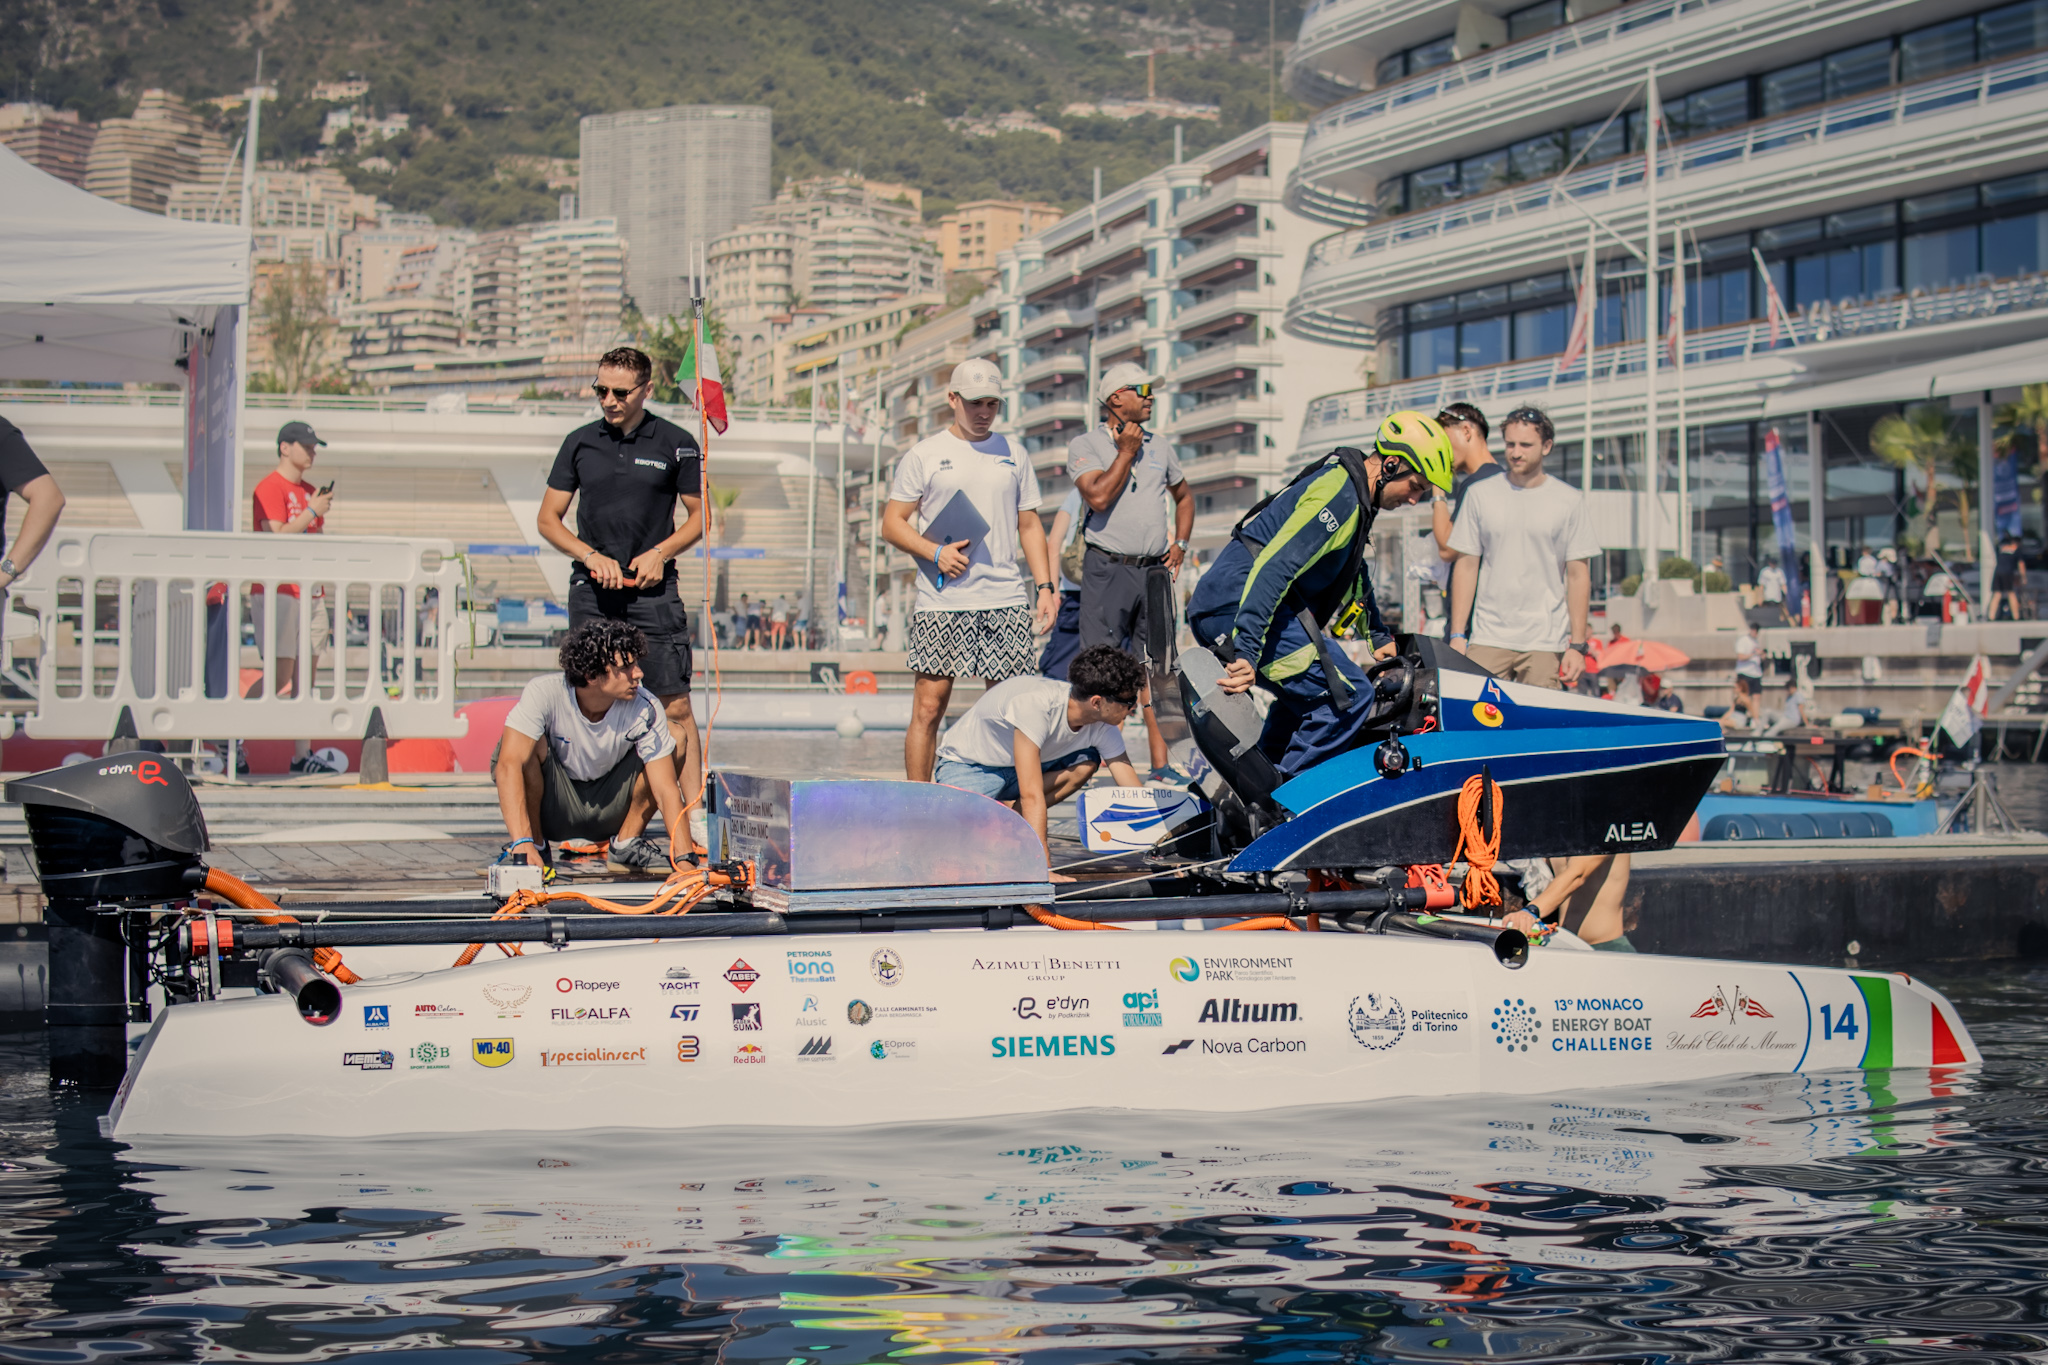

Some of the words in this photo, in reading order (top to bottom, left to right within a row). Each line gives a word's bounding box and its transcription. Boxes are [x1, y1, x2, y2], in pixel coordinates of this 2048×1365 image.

[1604, 822, 1658, 842] ALEA
[788, 960, 834, 975] iona
[972, 958, 1041, 970] AZIMUT
[1049, 958, 1121, 969] BENETTI
[1204, 958, 1293, 969] ENVIRONMENT
[728, 971, 757, 981] VABER
[1206, 971, 1234, 981] PARK
[575, 980, 620, 992] Ropeye
[659, 982, 700, 990] YACHT
[1047, 996, 1089, 1010] e'dyn
[1577, 998, 1643, 1011] MONACO
[1123, 1014, 1162, 1026] FORMAZIONE
[1411, 1009, 1468, 1020] Politecnico
[796, 1017, 827, 1026] Alusic
[1412, 1022, 1422, 1031] di
[1425, 1021, 1458, 1031] Torino
[1552, 1018, 1609, 1031] ENERGY
[1614, 1018, 1652, 1031] BOAT
[1820, 1003, 1859, 1040] 14
[1202, 1039, 1243, 1054] Nova
[1248, 1038, 1306, 1053] Carbon
[1552, 1037, 1652, 1051] CHALLENGE
[1666, 1031, 1702, 1050] Yacht
[1704, 1030, 1734, 1050] Club
[1737, 1037, 1748, 1049] de
[1751, 1030, 1797, 1049] Monaco
[477, 1042, 511, 1054] WD-40
[992, 1035, 1116, 1058] SIEMENS
[734, 1056, 749, 1064] Red
[751, 1055, 765, 1063] Bull
